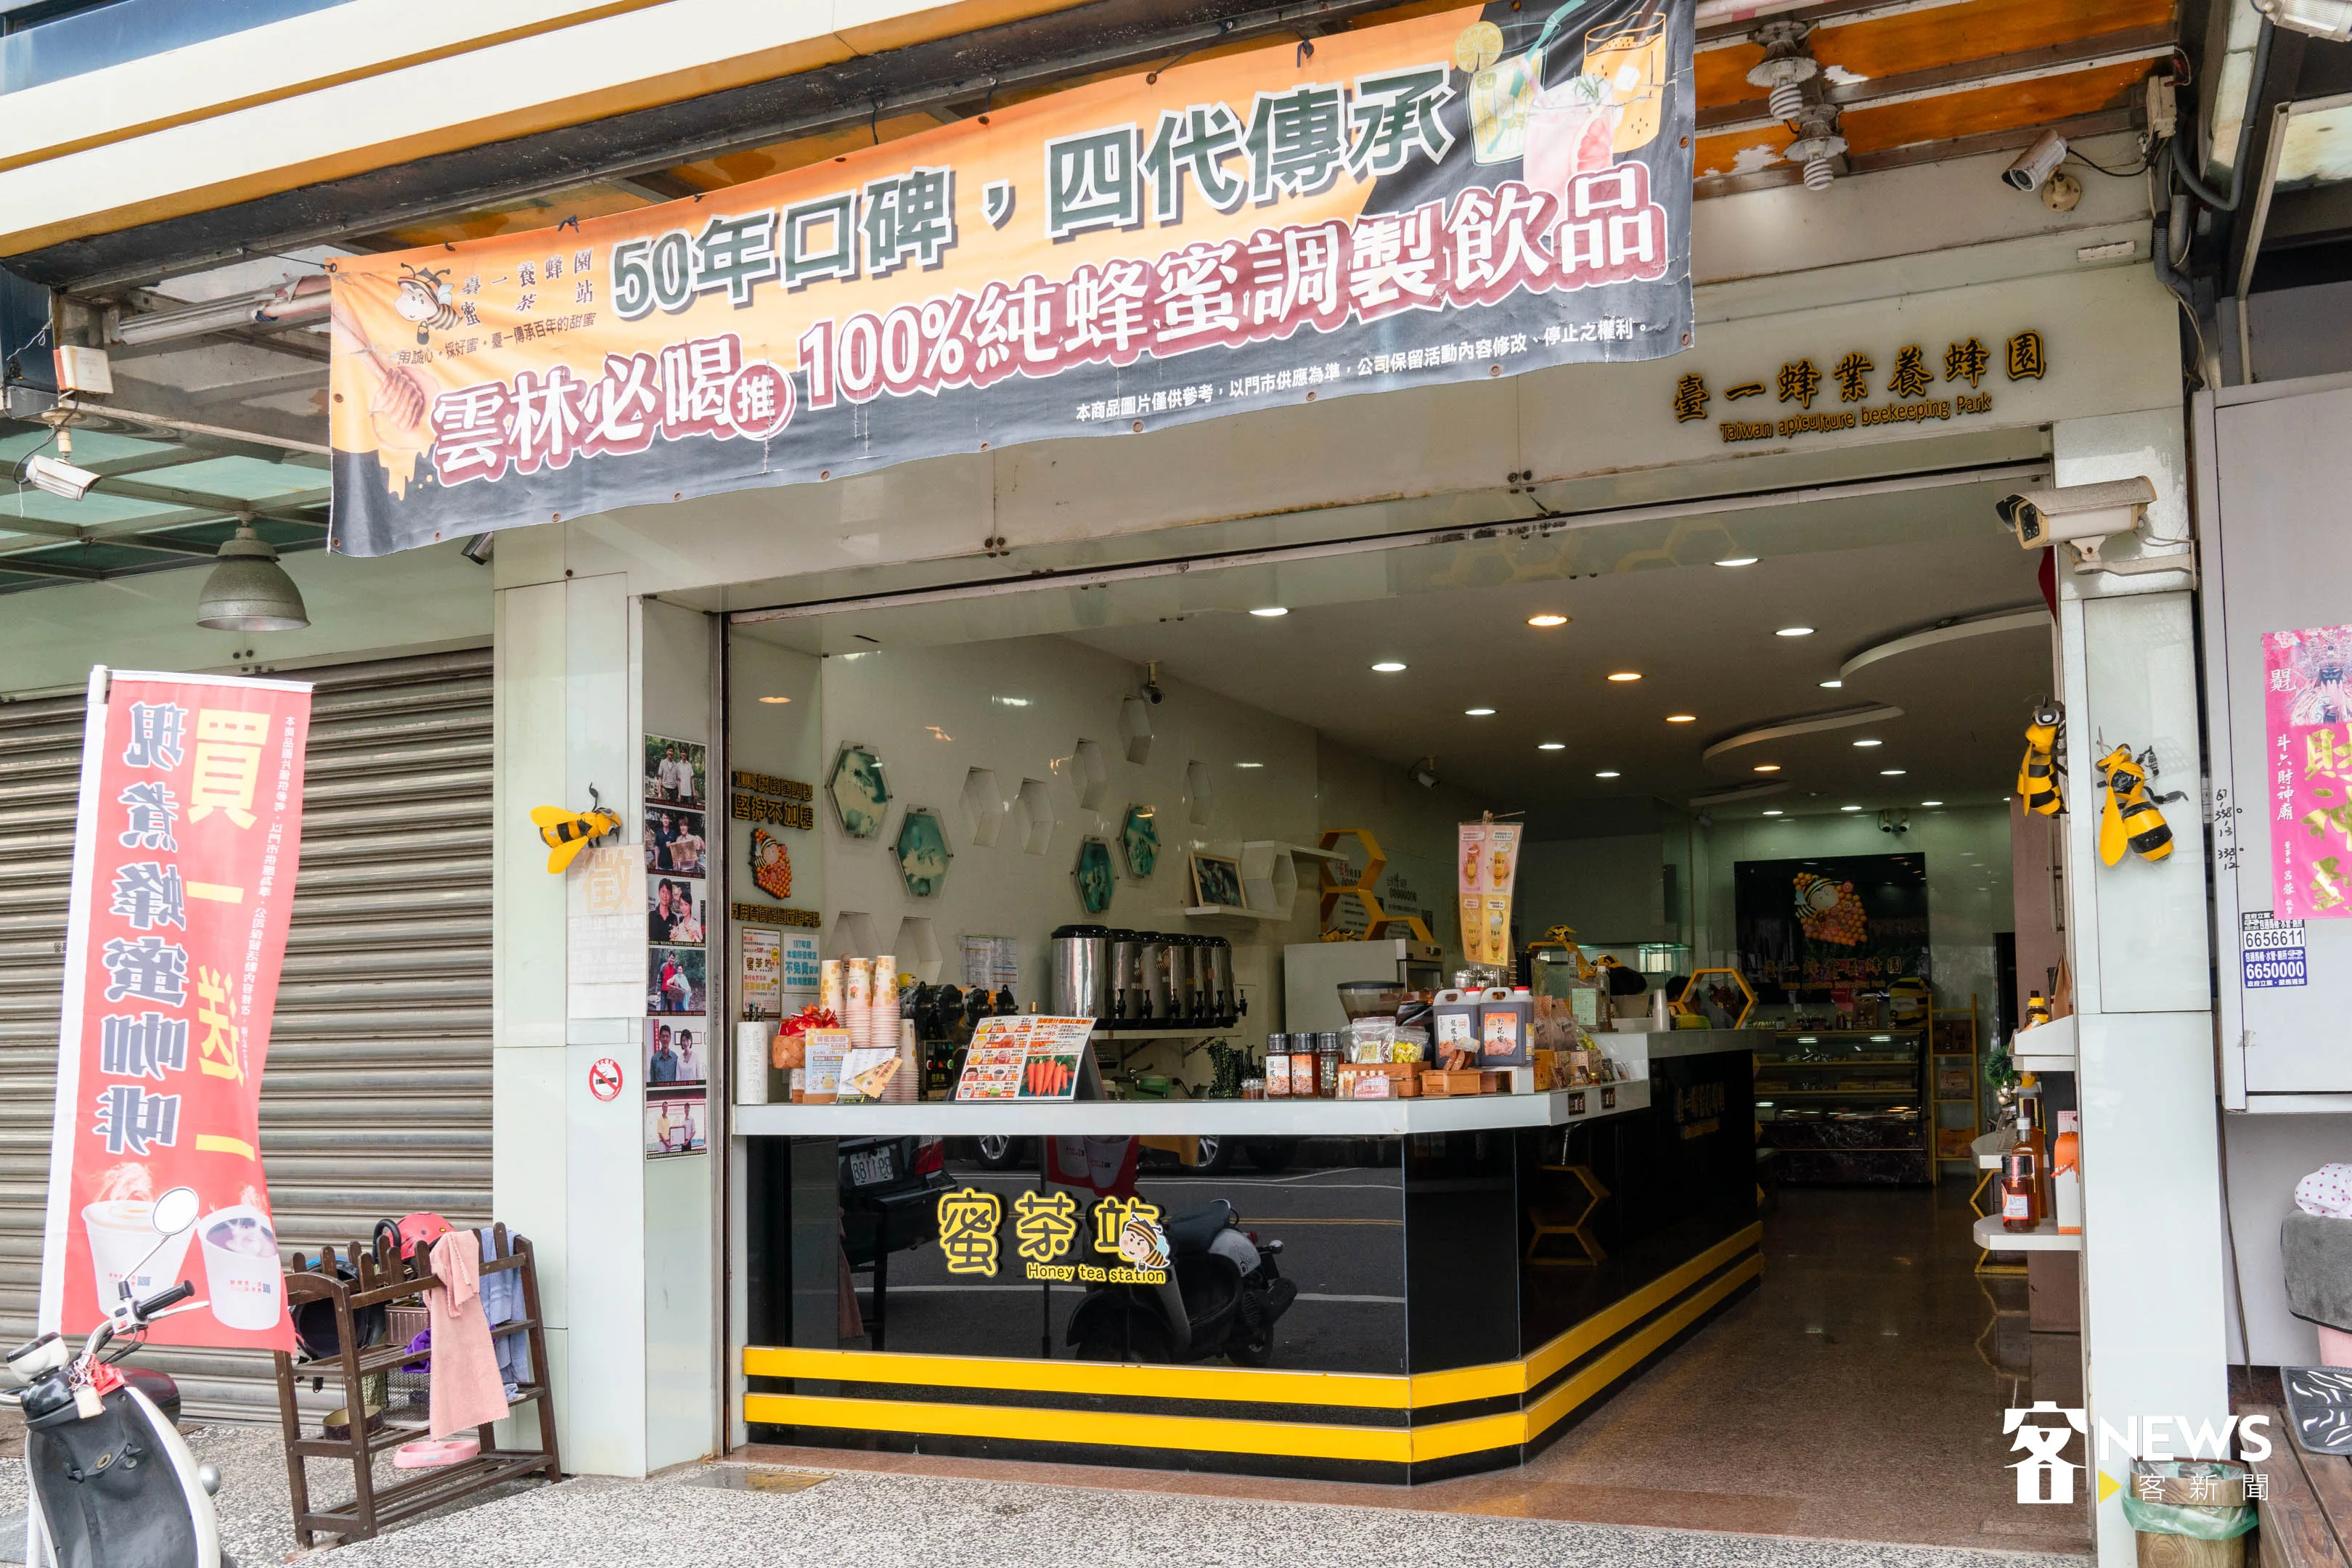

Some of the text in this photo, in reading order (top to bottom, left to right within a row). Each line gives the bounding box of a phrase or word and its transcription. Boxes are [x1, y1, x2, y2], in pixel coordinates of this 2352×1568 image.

[460, 248, 593, 296] 臺一養蜂園
[433, 162, 1667, 485] 雲林必喝 推 100%純蜂蜜調製飲品
[461, 279, 593, 327] 蜜茶站
[1673, 330, 2045, 422] 臺一蜂業養蜂園
[1720, 392, 1992, 441] Taiwan apiculture beekeeping Park
[2277, 734, 2294, 821] 斗六財神廟
[735, 793, 814, 830] 堅持不加糖
[2246, 929, 2303, 947] 6656611
[2246, 961, 2304, 979] 6650000
[938, 1188, 1161, 1278] 蜜茶站
[1026, 1262, 1165, 1283] Honey tea station
